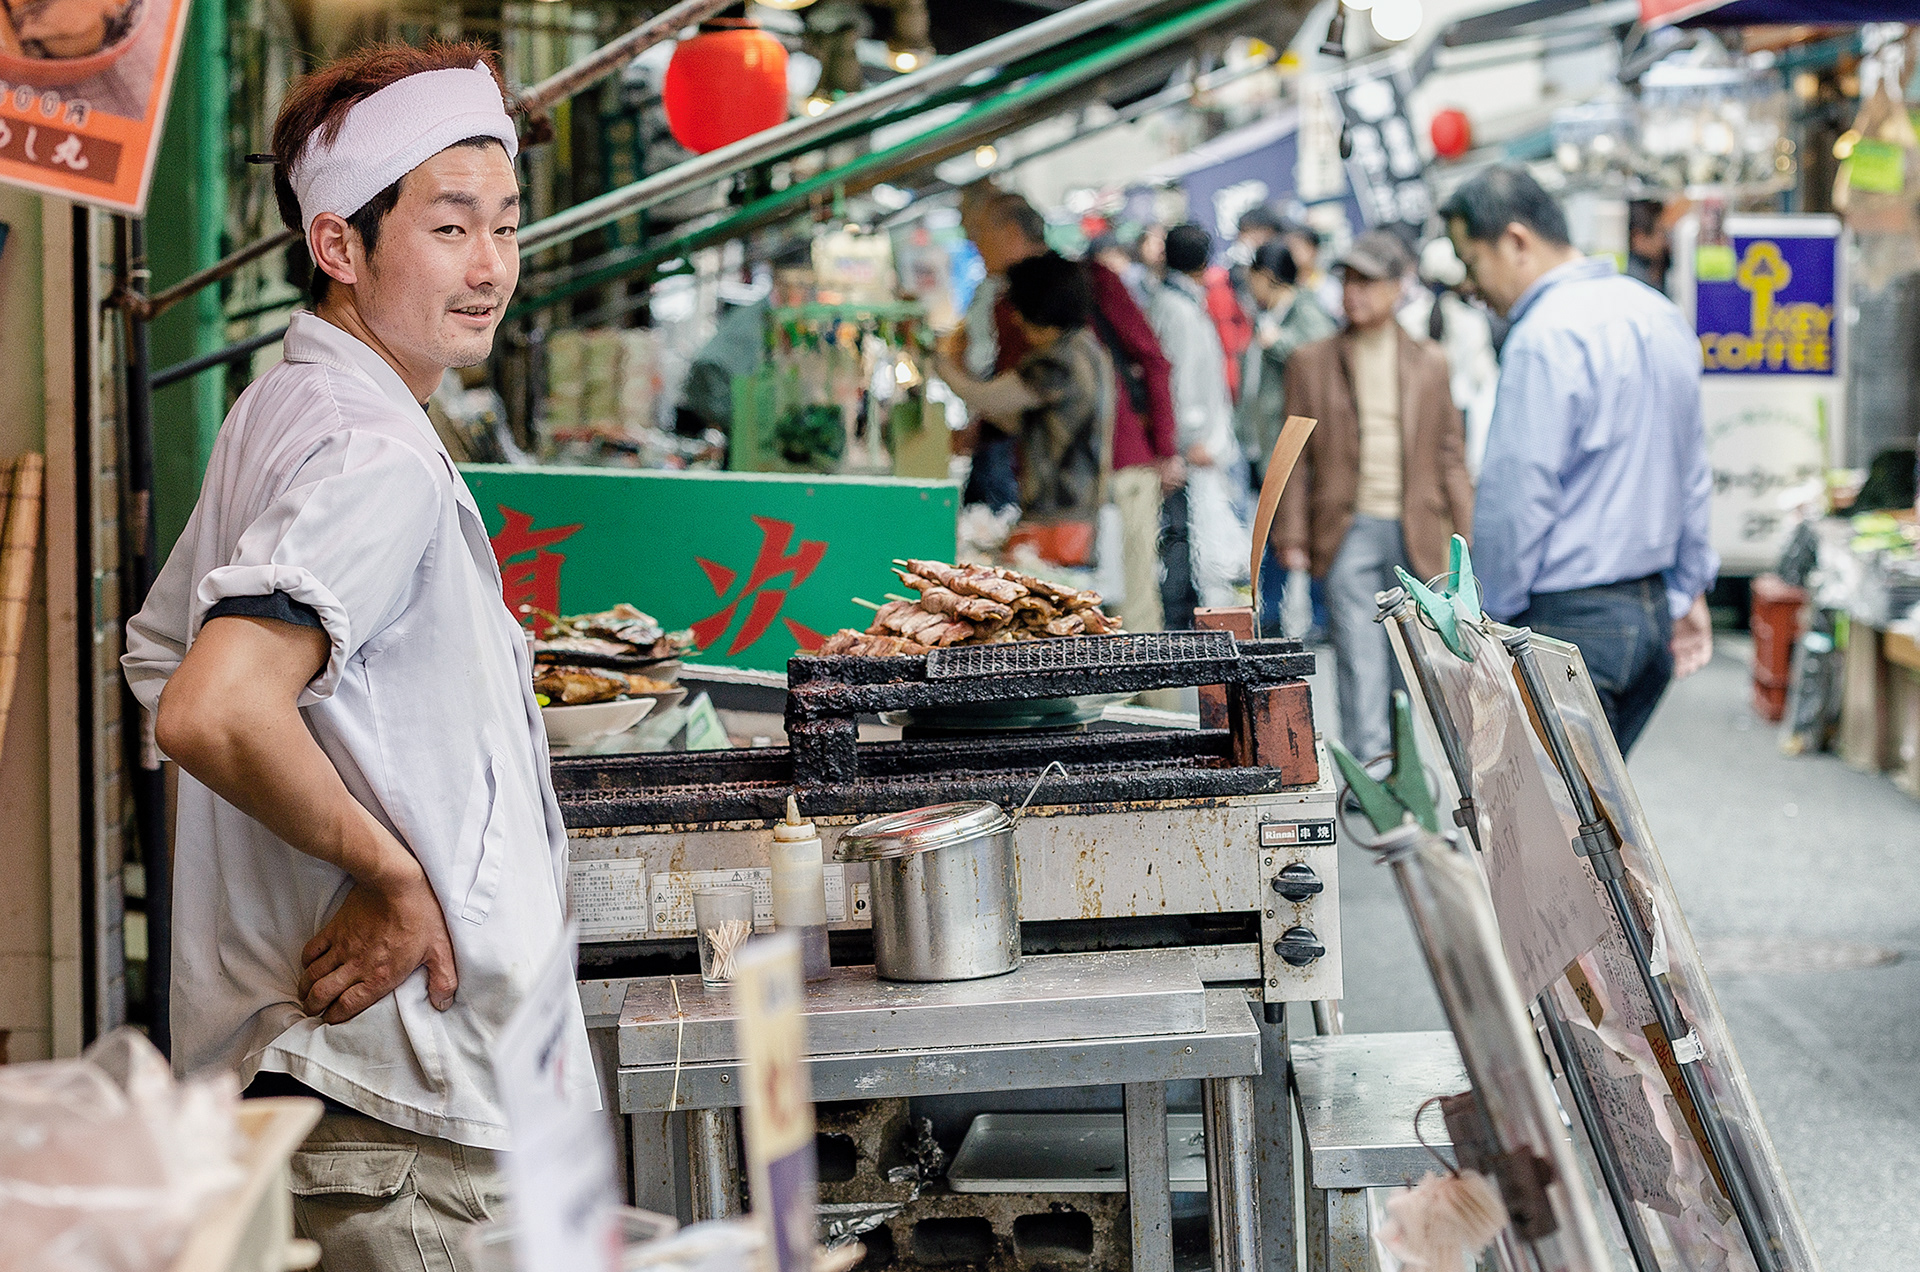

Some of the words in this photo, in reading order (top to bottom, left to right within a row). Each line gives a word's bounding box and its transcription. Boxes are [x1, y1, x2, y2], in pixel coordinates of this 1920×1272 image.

[0, 80, 92, 129] 00円
[1773, 301, 1834, 342] KEY
[1700, 331, 1833, 371] COFFEE
[1265, 830, 1295, 839] Rinnai
